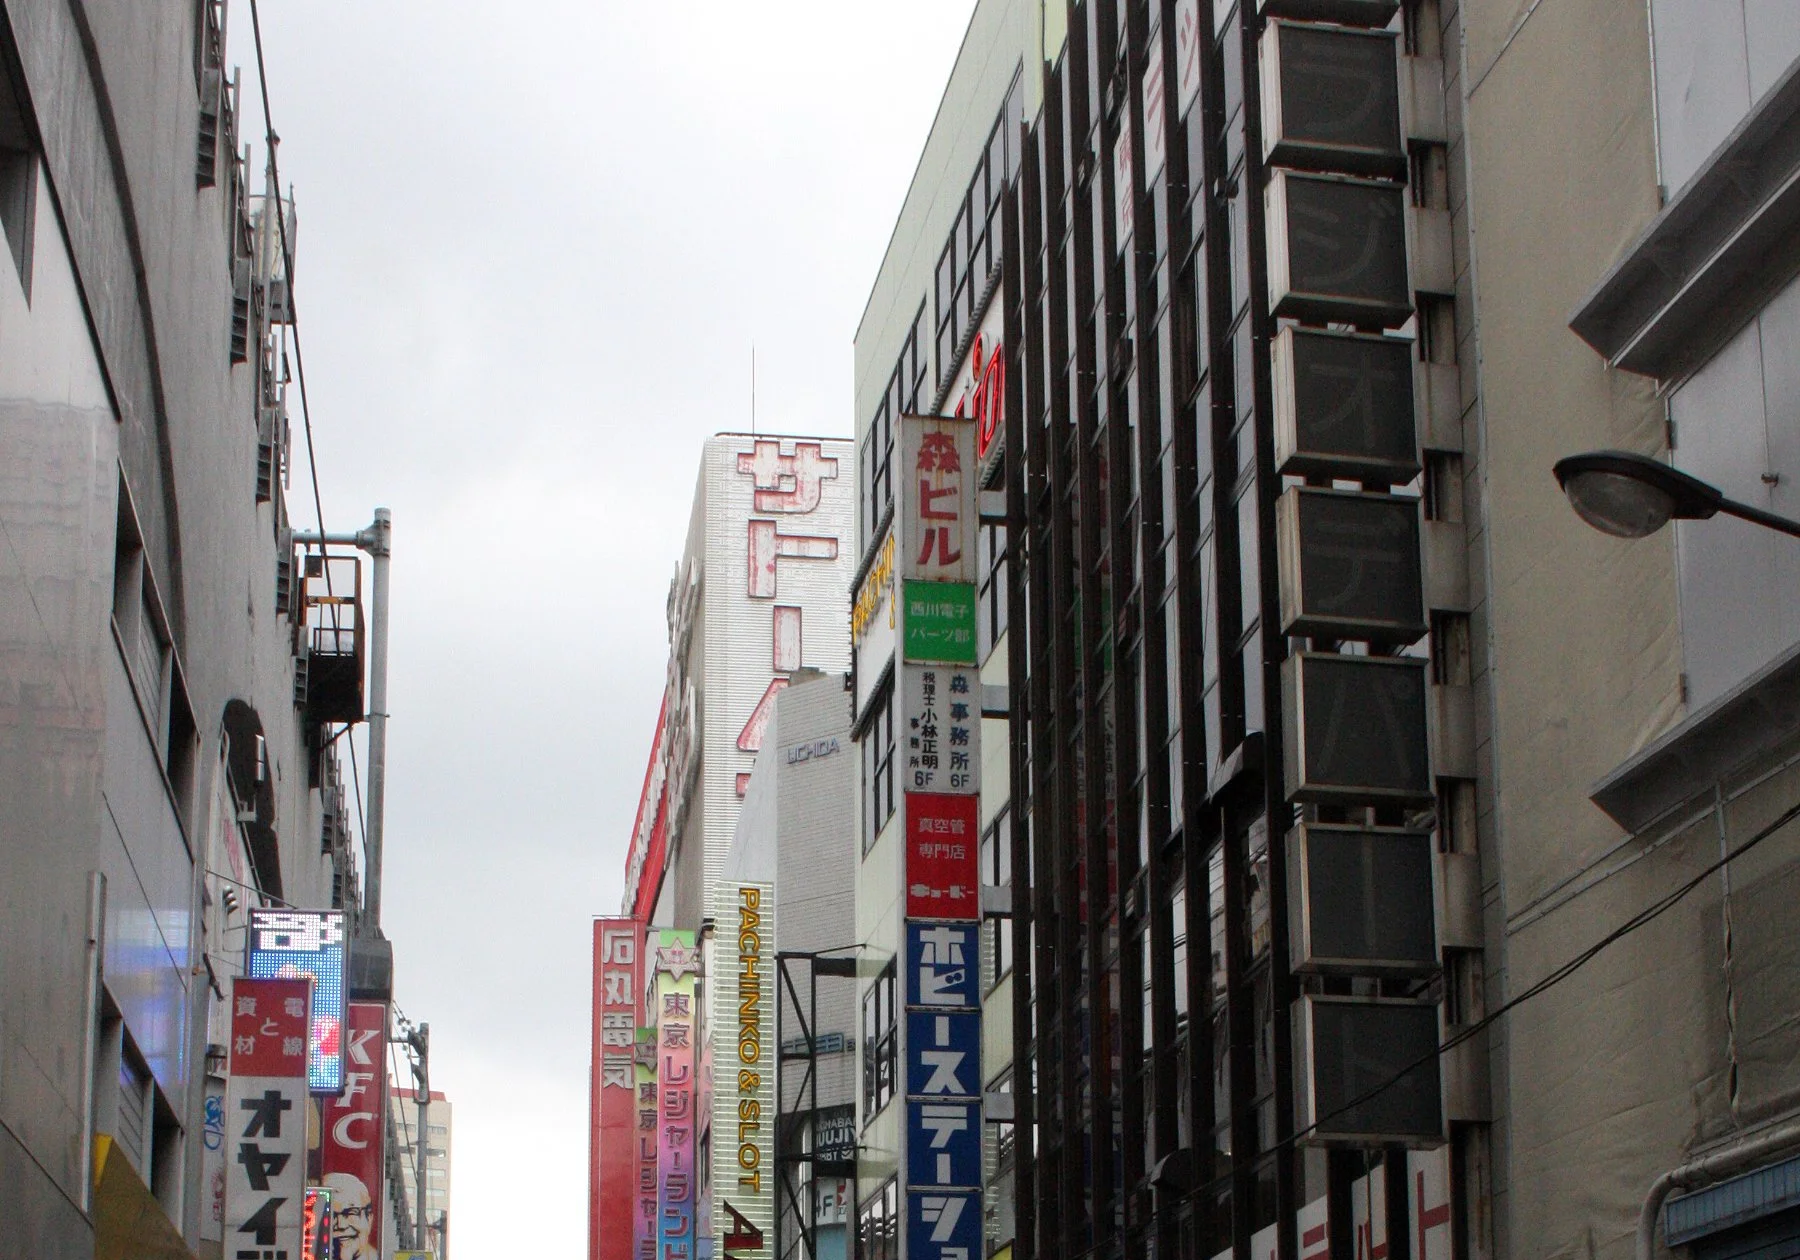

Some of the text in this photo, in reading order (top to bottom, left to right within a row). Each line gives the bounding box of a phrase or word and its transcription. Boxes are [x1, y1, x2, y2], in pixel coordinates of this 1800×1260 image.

[915, 431, 962, 566] 森ビル
[910, 601, 969, 619] 西川電子
[949, 673, 970, 770] 森事務所
[914, 770, 934, 787] 6F
[950, 773, 970, 788] 6F
[918, 818, 965, 835] 真空管
[260, 1018, 280, 1037] と
[602, 928, 634, 1090] 石丸電気
[738, 887, 761, 1194] PACHINKO & SLOT
[331, 1029, 380, 1150] KFC
